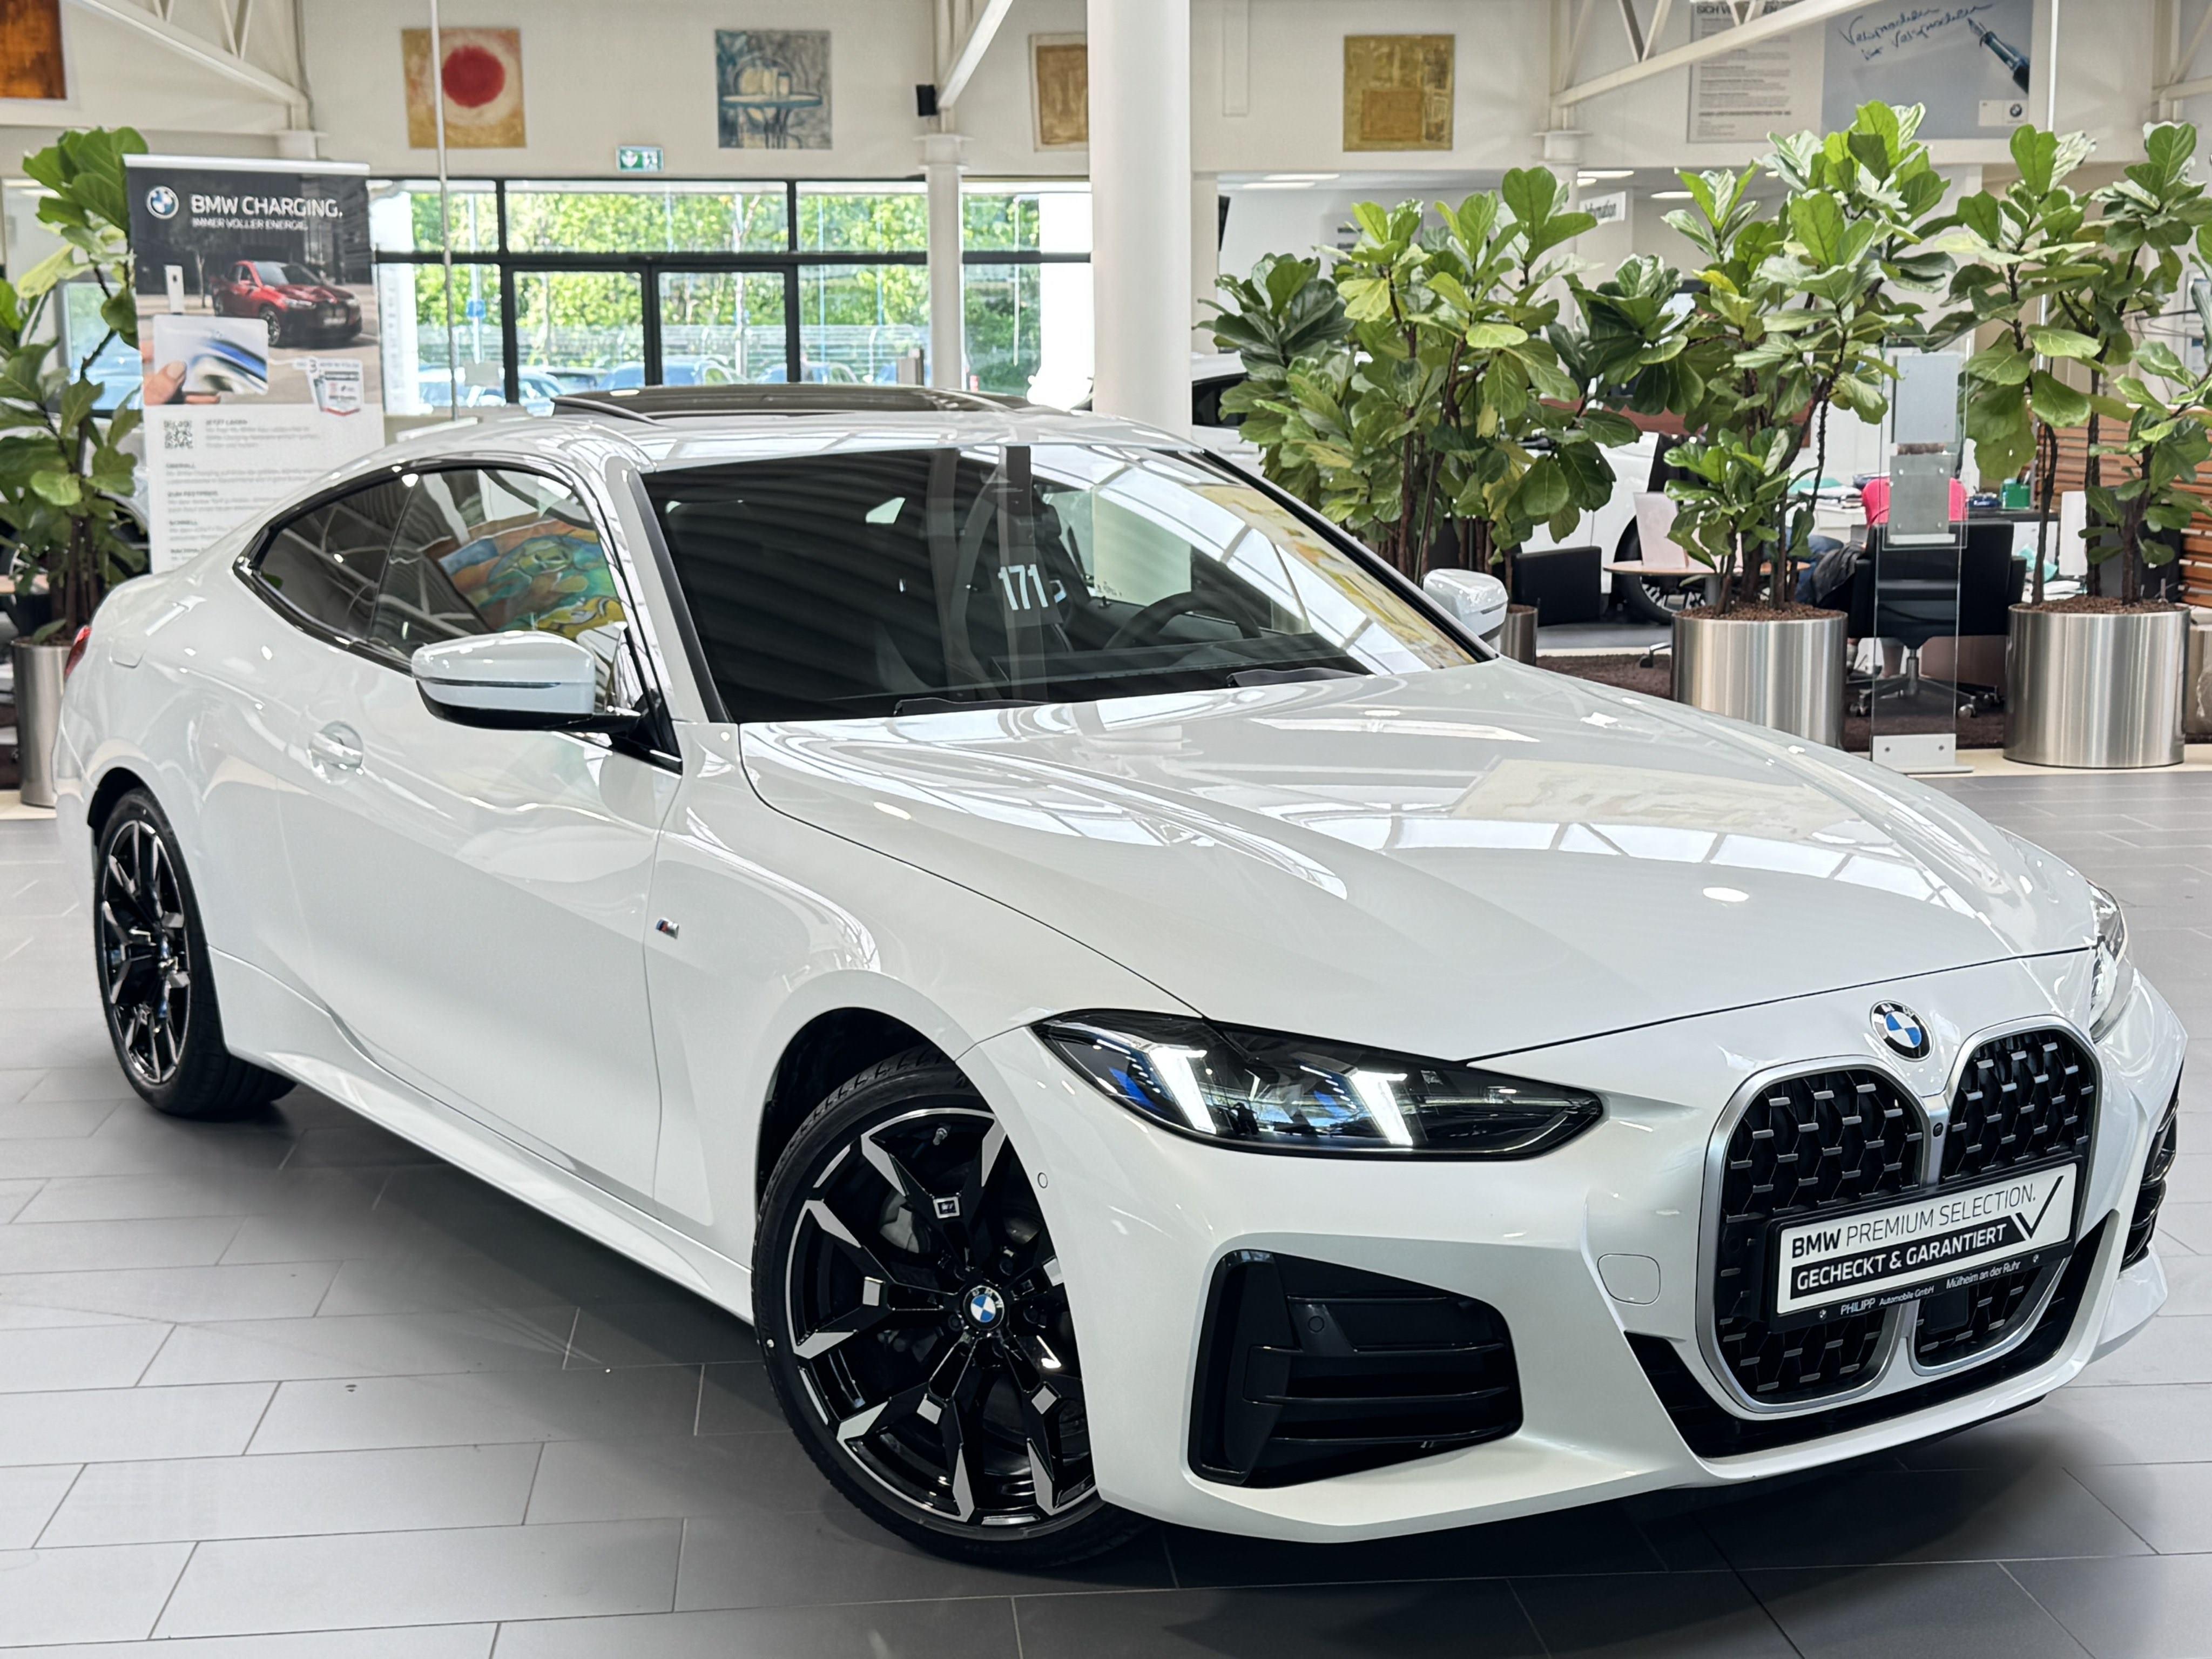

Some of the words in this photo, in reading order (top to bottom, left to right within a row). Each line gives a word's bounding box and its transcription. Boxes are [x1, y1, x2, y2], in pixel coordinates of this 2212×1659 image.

[191, 194, 238, 215] BMW
[242, 196, 343, 218] CHARGING.
[226, 218, 264, 230] VOLLER
[998, 564, 1048, 610] 171
[1792, 1228, 1841, 1259] BMW
[1846, 1208, 1934, 1246] PREMIUM
[1939, 1183, 2036, 1226] SELECTION.
[1797, 1253, 1887, 1290] GECHECKT
[1889, 1251, 1902, 1270] &
[1906, 1223, 2007, 1265] GARANTIERT
[1840, 1298, 1876, 1315] PHILIPP
[1879, 1291, 1914, 1306] Automobile
[1914, 1285, 1934, 1297] GmbH
[1946, 1273, 1979, 1289] Mülheim
[1979, 1271, 1989, 1280] an
[1990, 1266, 2002, 1277] der
[2002, 1261, 2021, 1273] Ruhr
